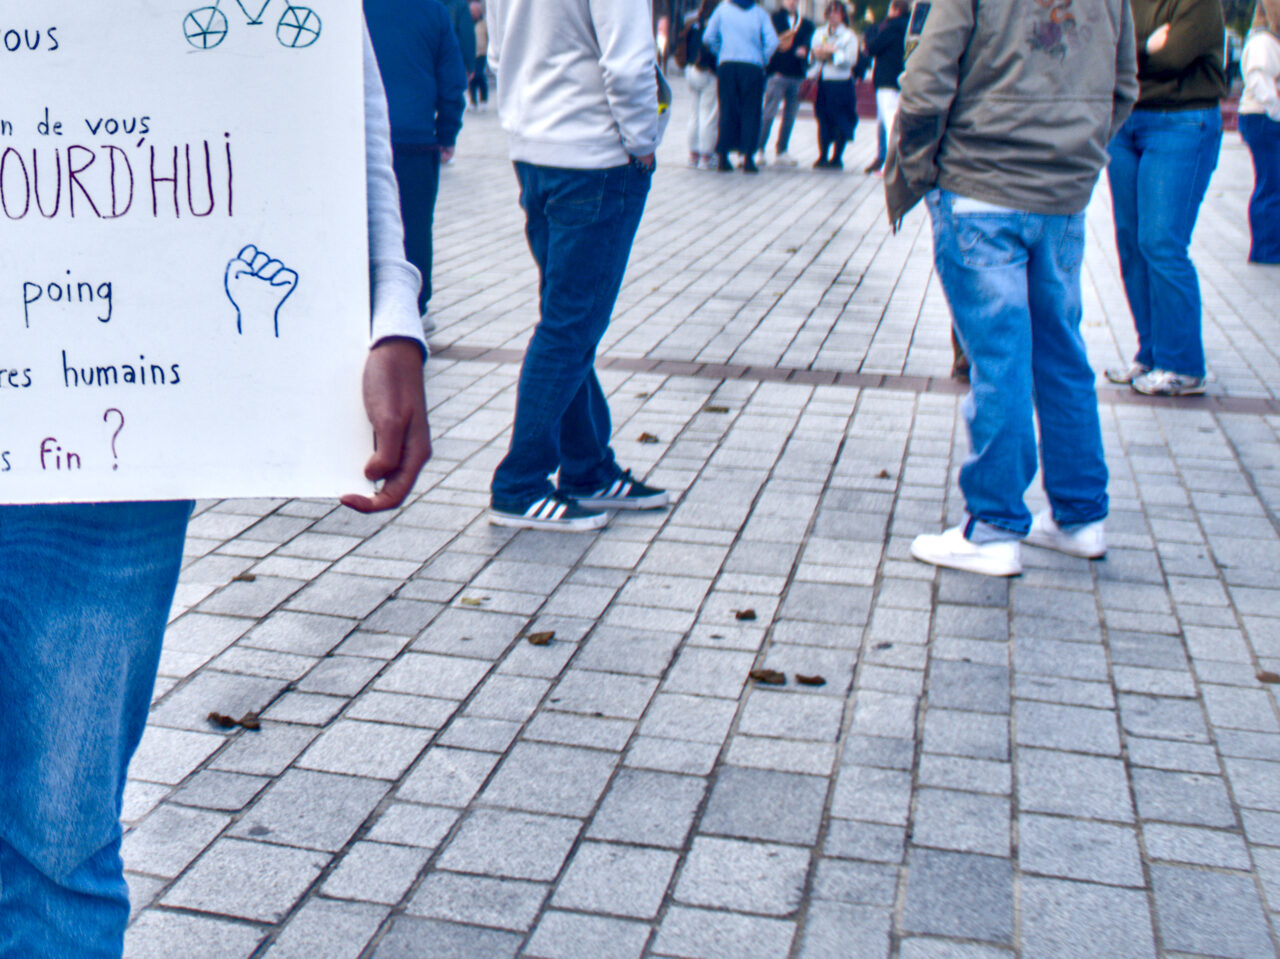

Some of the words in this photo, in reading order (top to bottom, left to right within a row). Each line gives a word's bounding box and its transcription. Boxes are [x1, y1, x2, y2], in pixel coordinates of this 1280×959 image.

[37, 106, 64, 136] de
[84, 115, 151, 136] vous
[22, 270, 113, 329] poing
[61, 348, 182, 388] humains
[39, 436, 82, 472] fin
[102, 407, 125, 471] ?
